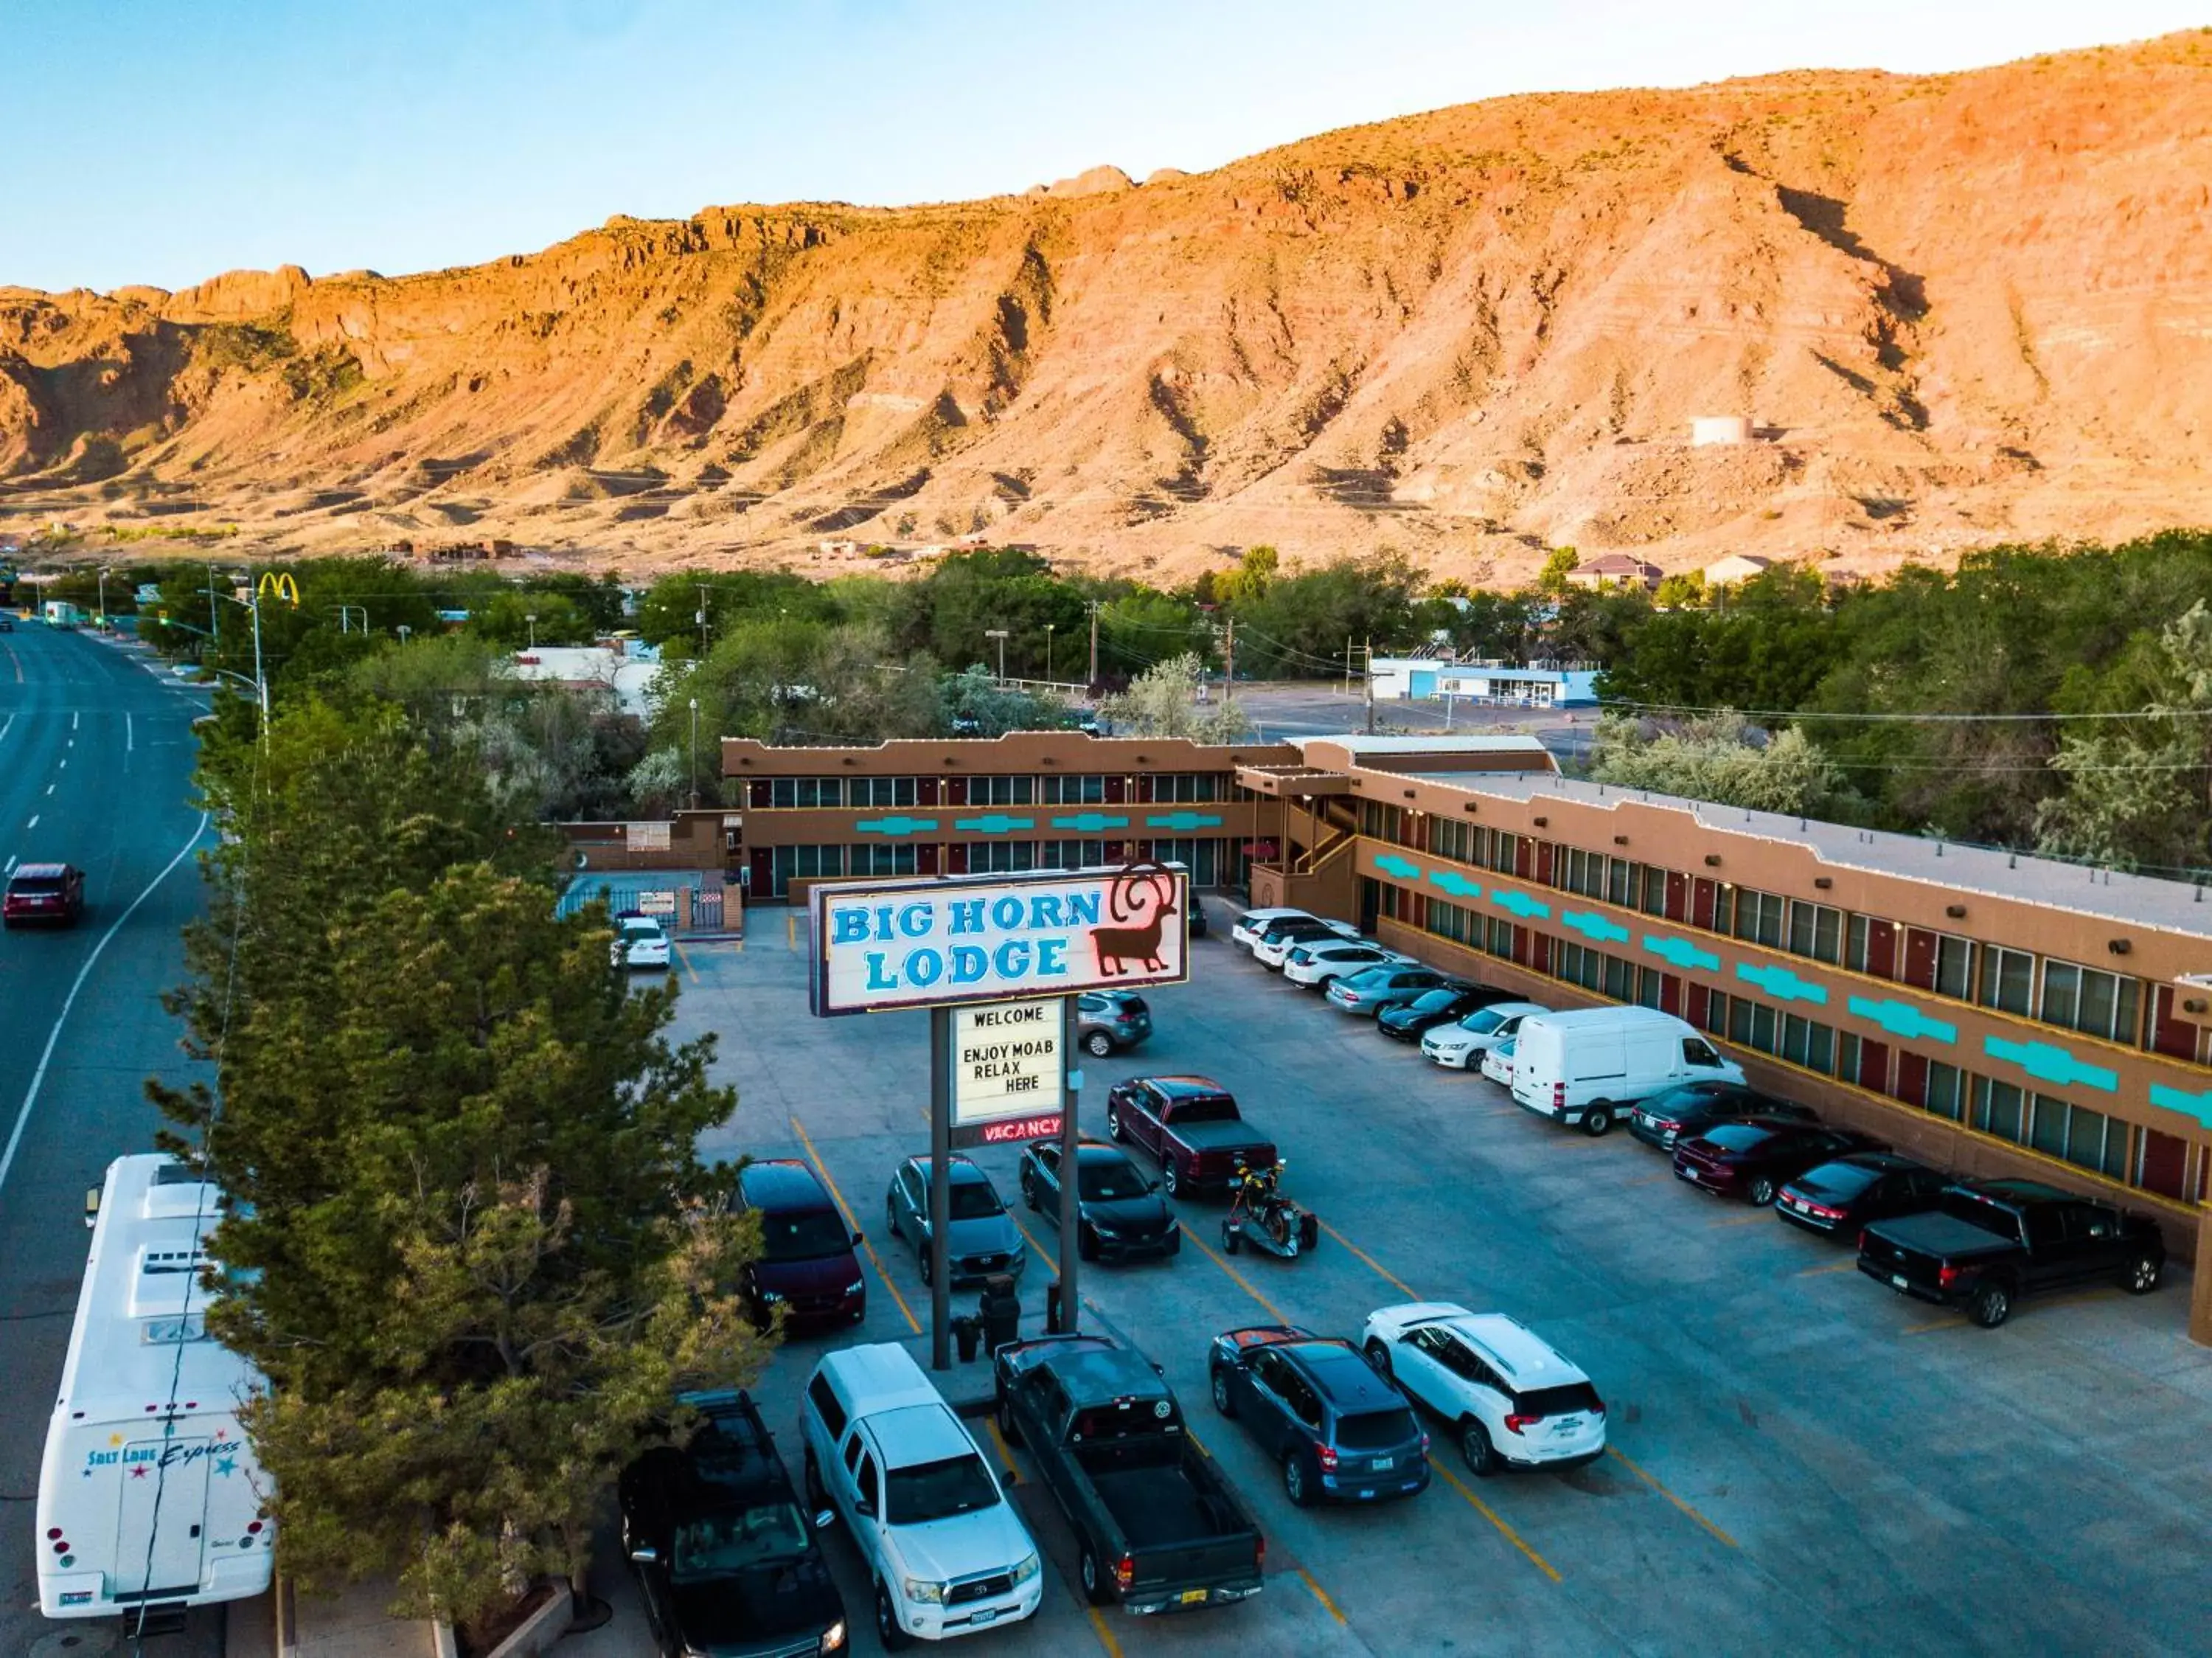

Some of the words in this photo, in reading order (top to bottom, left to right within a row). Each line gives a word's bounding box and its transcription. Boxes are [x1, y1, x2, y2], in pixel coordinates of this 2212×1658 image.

[832, 901, 933, 945] BIG
[948, 890, 1102, 935] HORN
[864, 937, 1068, 992] LODGE
[974, 1007, 1043, 1027] WELCOME
[963, 1044, 1009, 1063] ENJOY
[1012, 1039, 1054, 1057] MOAB
[974, 1061, 1020, 1079] RELAX
[1006, 1075, 1039, 1092] HERE
[984, 1117, 1061, 1141] VACANCY
[157, 1440, 241, 1468] Express
